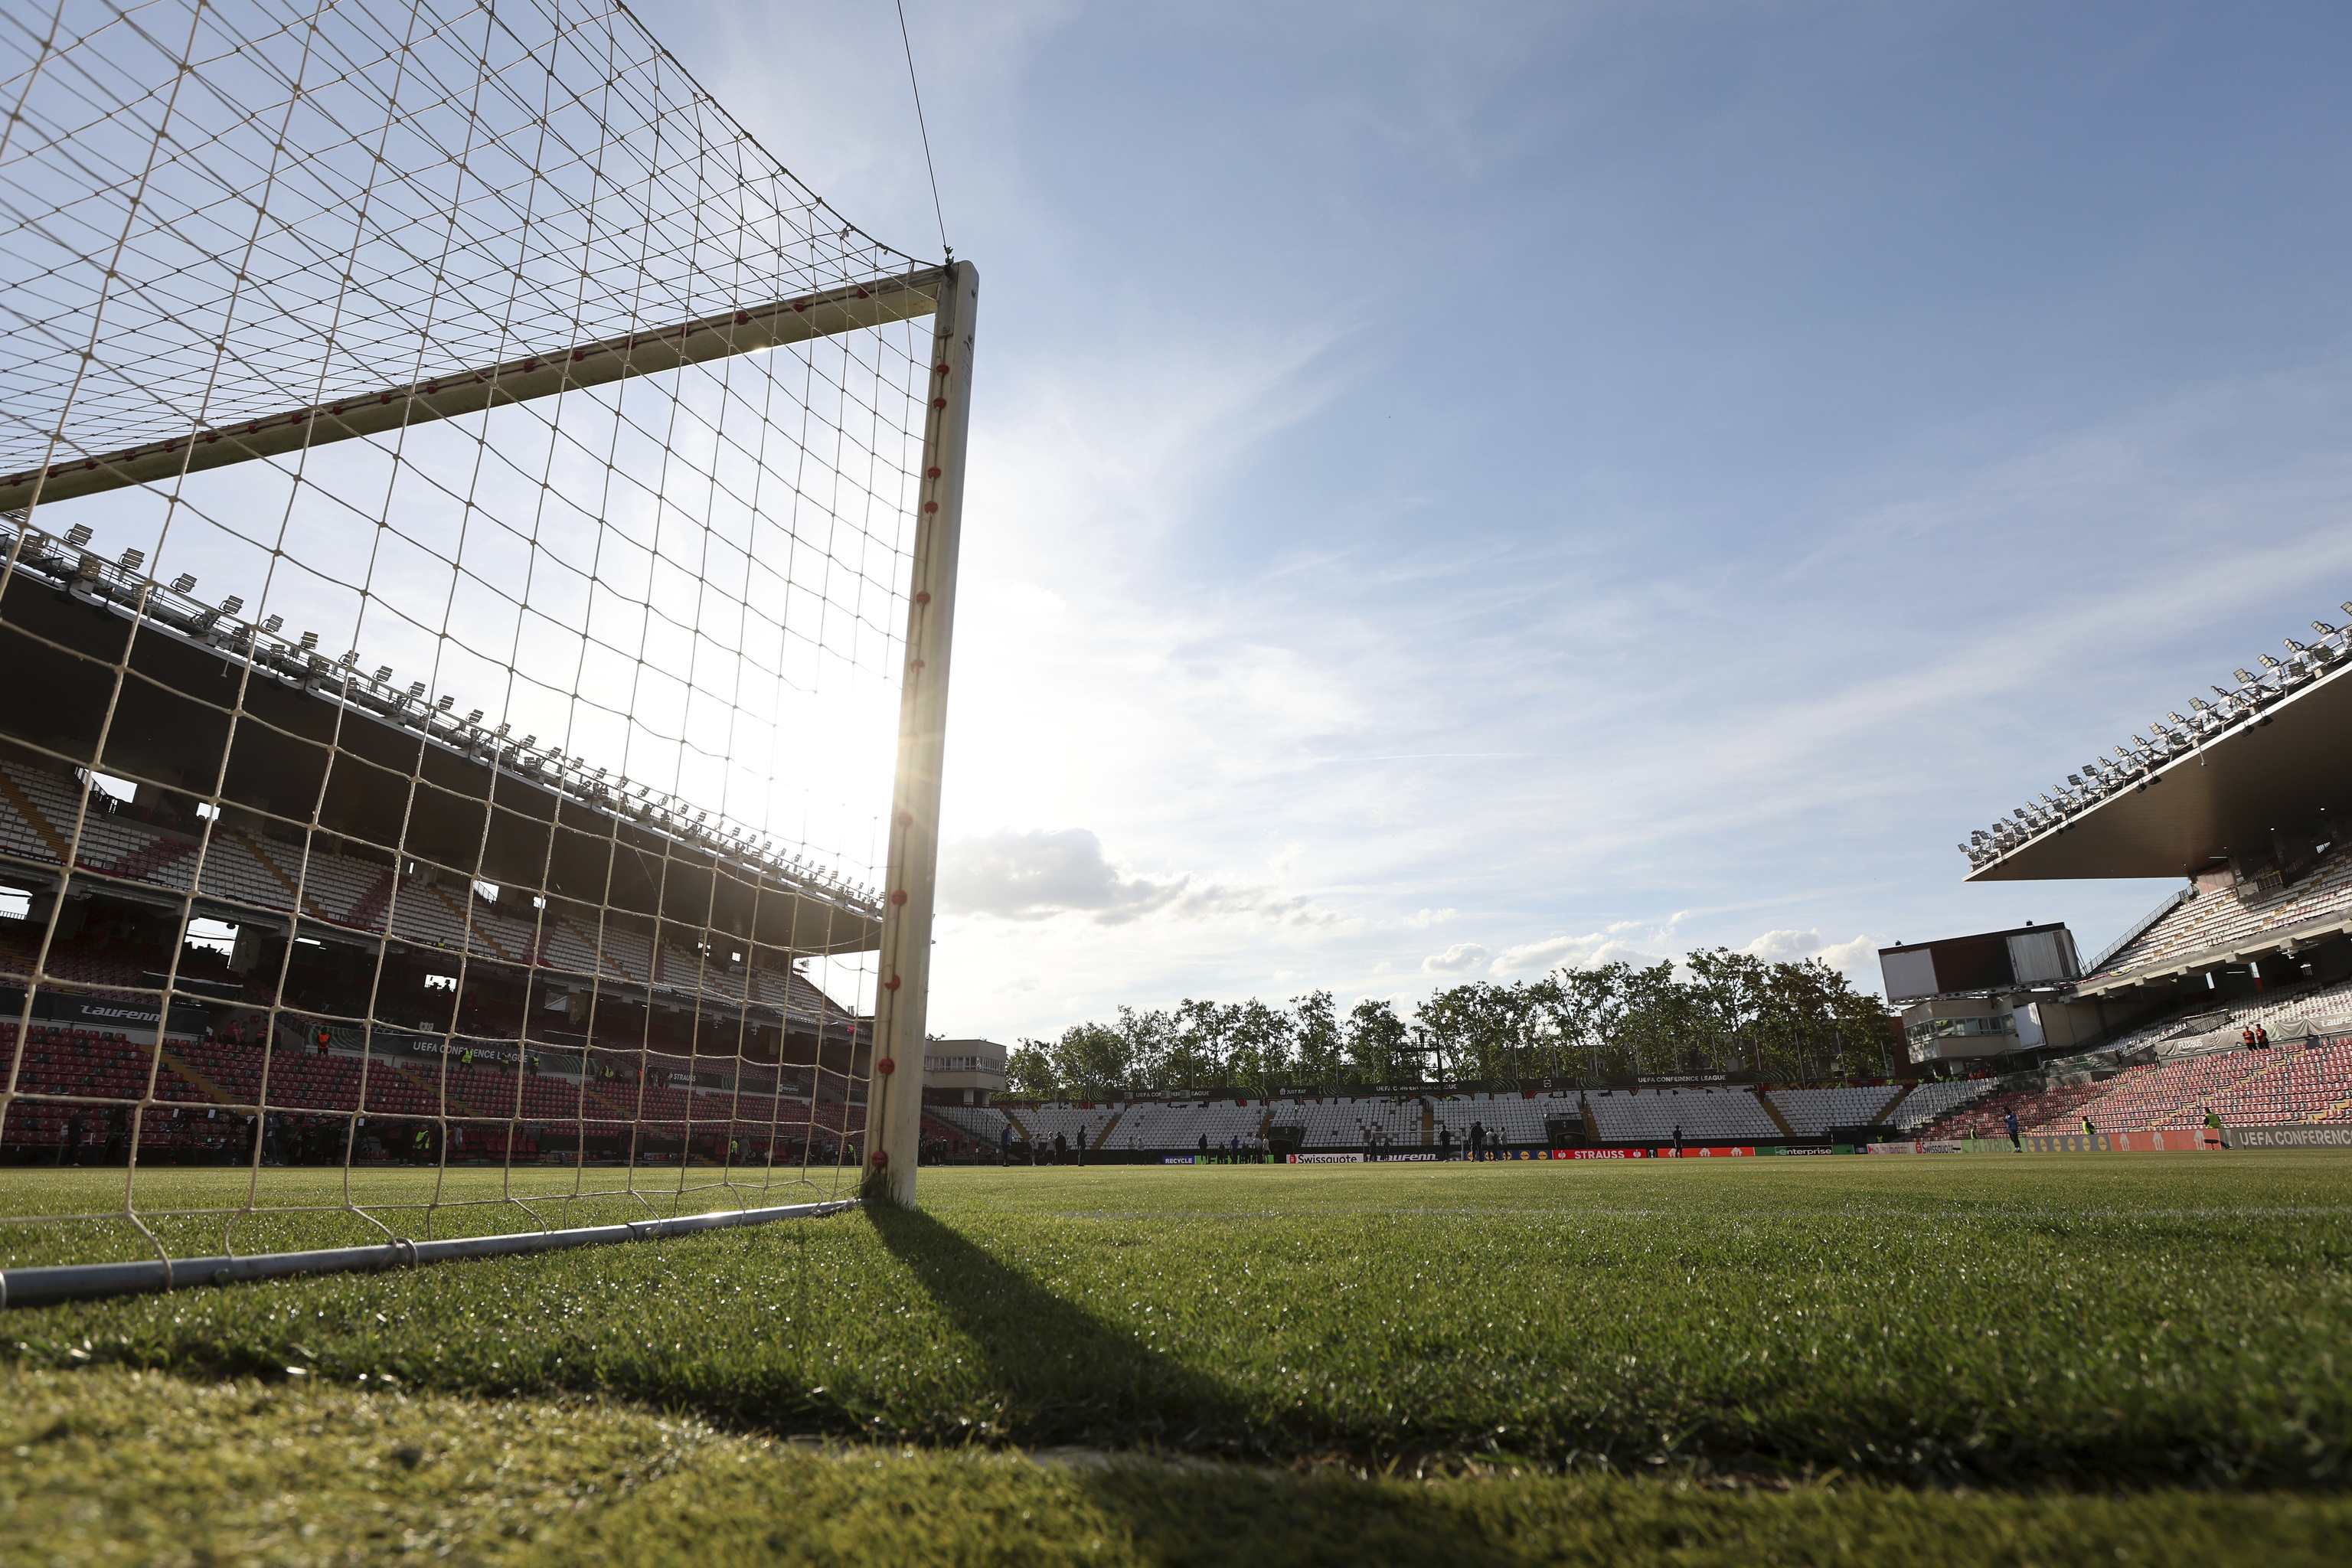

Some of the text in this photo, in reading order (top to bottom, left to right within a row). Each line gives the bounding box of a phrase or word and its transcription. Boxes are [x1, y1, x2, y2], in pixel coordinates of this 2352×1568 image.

[413, 1041, 437, 1052] UEFA
[674, 1073, 696, 1082] STRAUS
[2239, 1129, 2352, 1145] UEFA CONFERENC
[1574, 1150, 1625, 1159] STRAUSS
